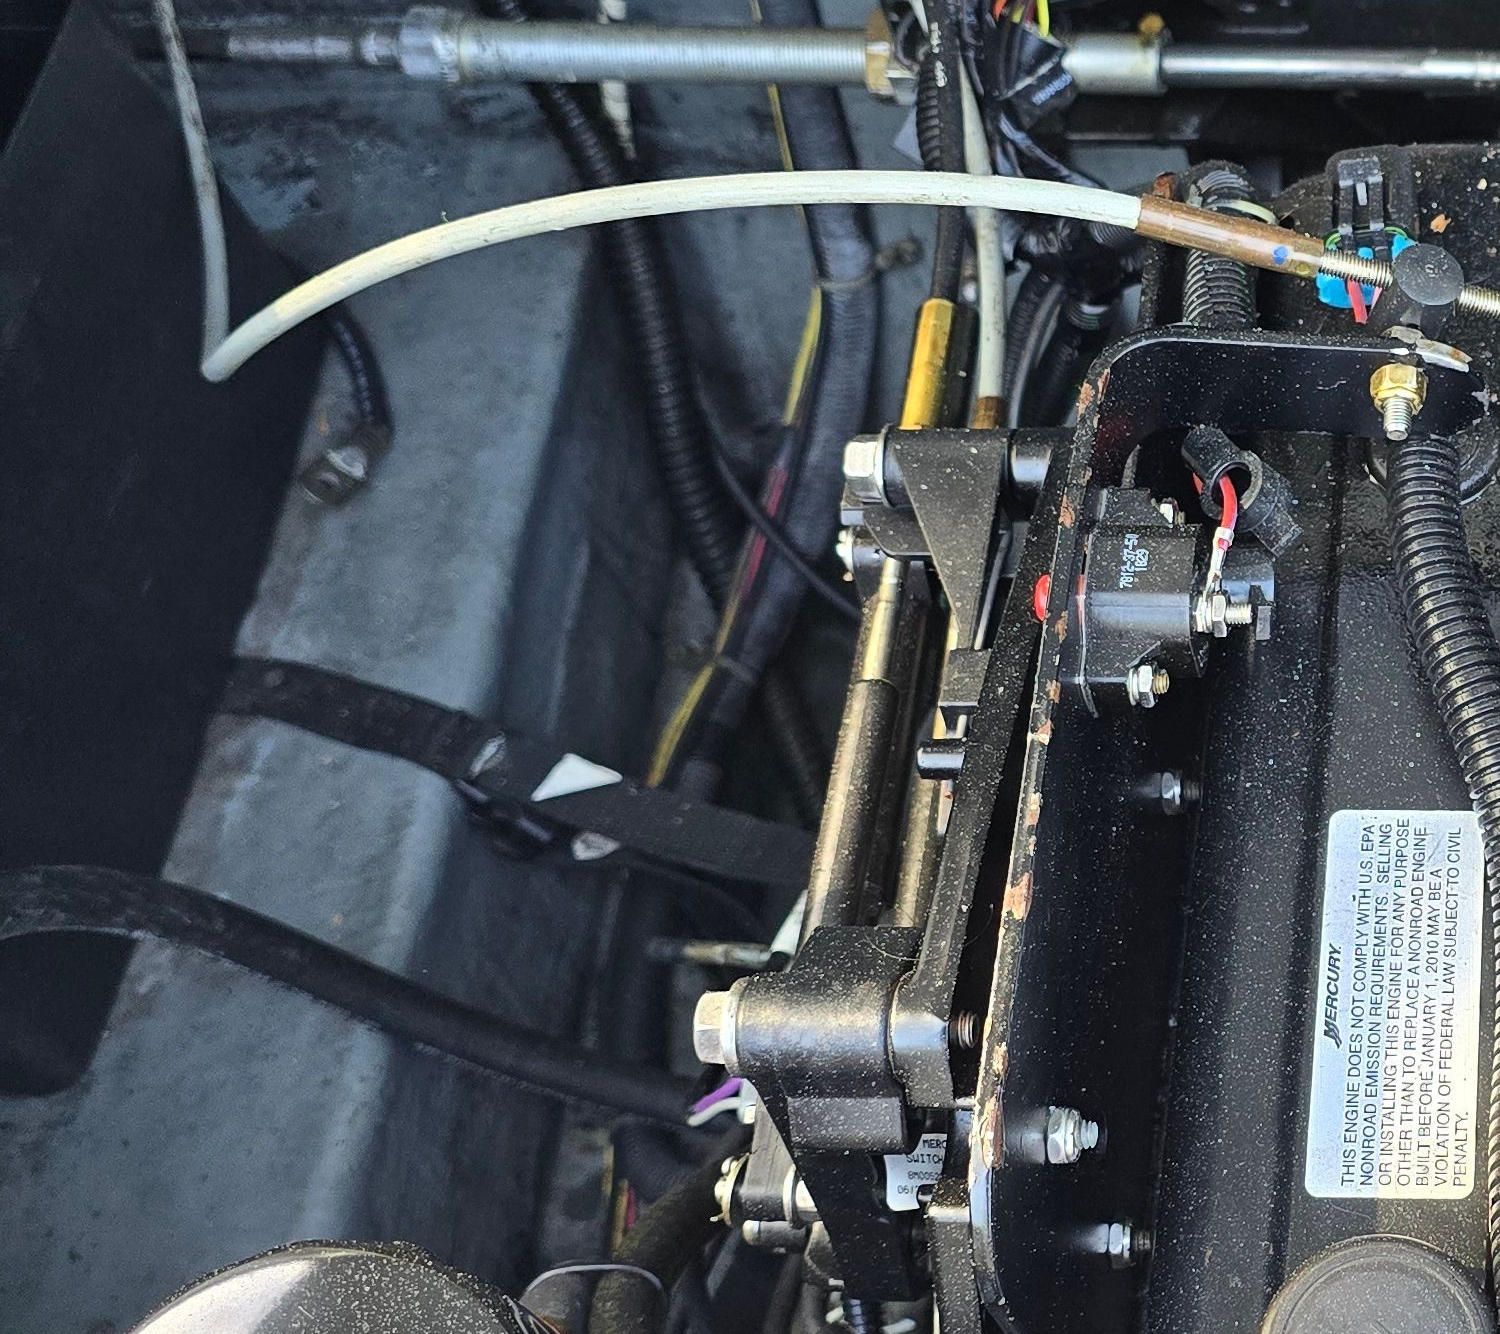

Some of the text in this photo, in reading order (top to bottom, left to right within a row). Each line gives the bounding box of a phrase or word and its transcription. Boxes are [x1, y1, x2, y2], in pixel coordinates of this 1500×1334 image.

[1323, 943, 1342, 1049] MERCURY
[1341, 824, 1375, 1186] THIS ENGINE DOES NOT COMPLY WITH U.S. EPA
[1359, 823, 1392, 1186] NONROAD EMISSION REQUIREMENTS. SELLING
[1378, 818, 1410, 1186] OR INSTALLING THIS ENGINE FOR ANY PURPOSE
